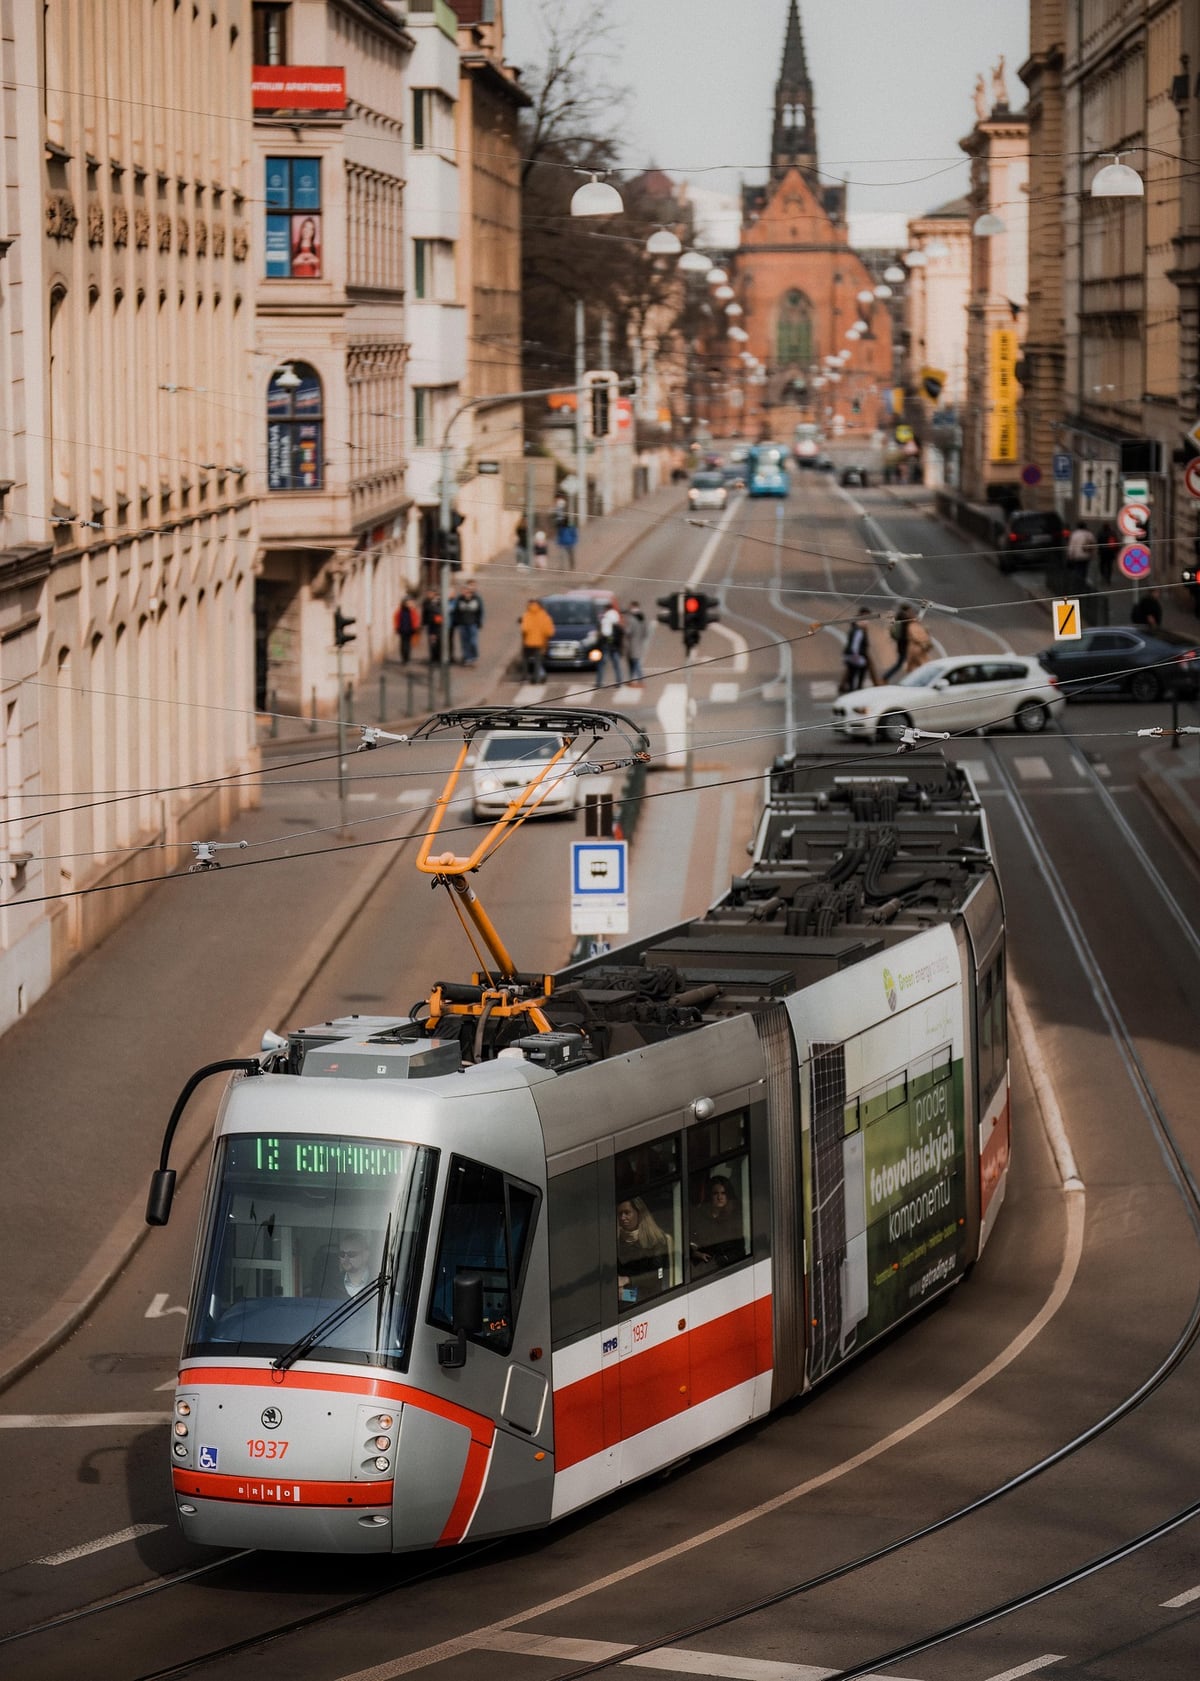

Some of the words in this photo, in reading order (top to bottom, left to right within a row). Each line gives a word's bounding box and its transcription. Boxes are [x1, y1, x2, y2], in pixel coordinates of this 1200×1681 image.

[915, 1075, 948, 1137] prodej
[870, 1120, 955, 1206] fotovoltaických
[888, 1166, 950, 1243] komponentů
[632, 1321, 648, 1343] 1937
[246, 1439, 289, 1459] 1937
